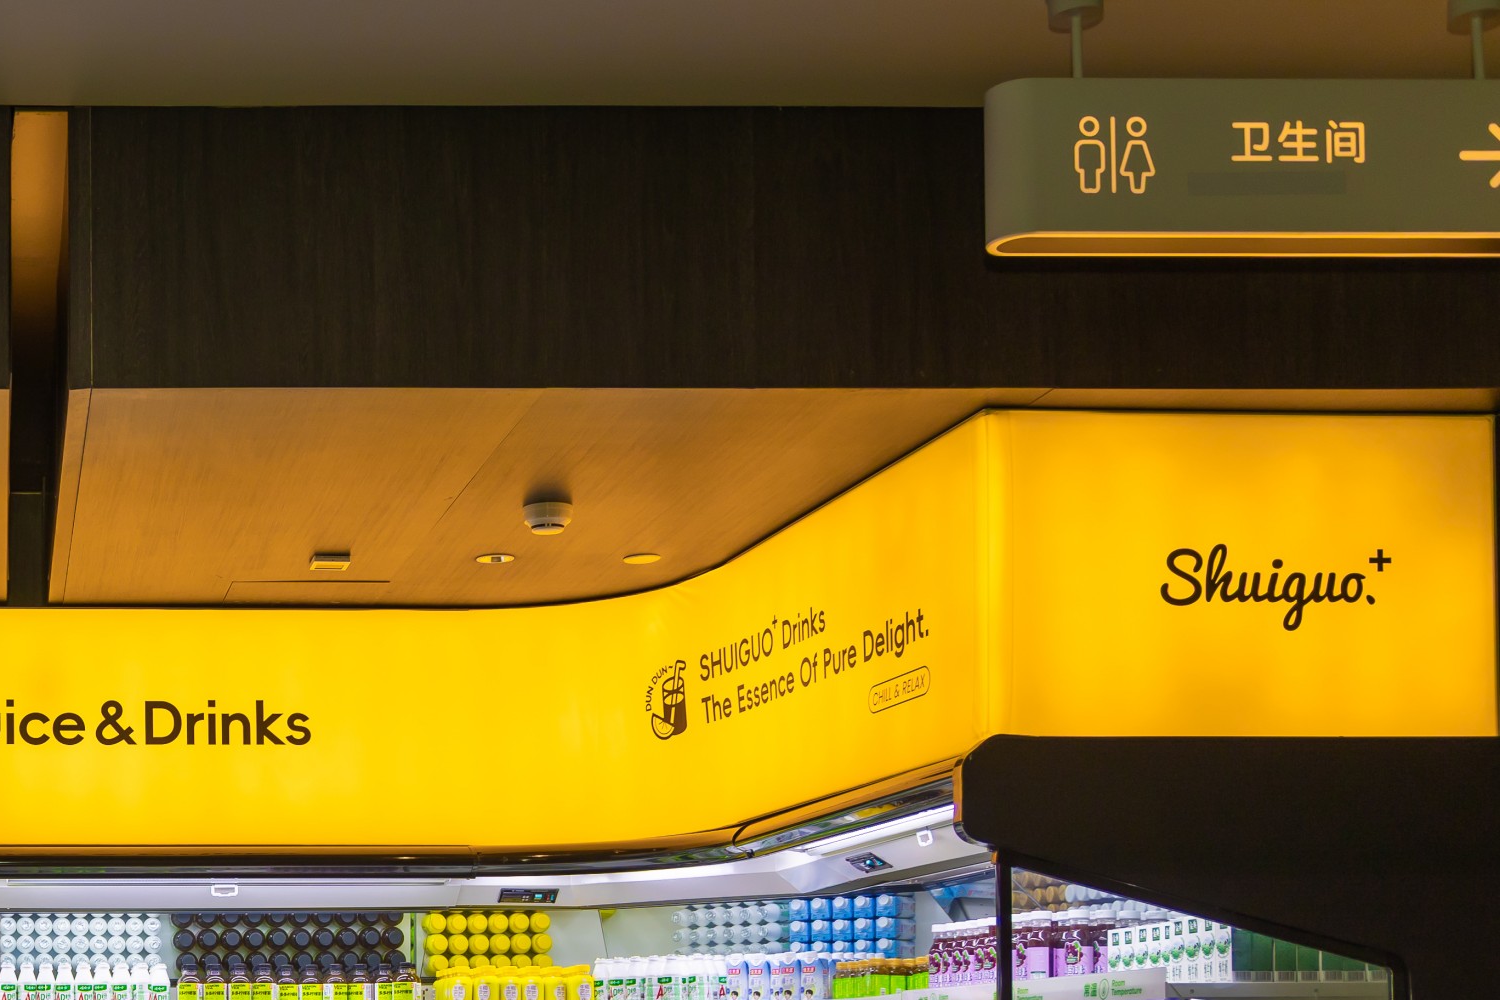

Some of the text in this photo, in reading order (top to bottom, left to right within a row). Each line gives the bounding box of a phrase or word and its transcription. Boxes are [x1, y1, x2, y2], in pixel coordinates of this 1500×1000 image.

[1231, 120, 1366, 164] 卫生间
[782, 607, 826, 650] Drinks
[701, 608, 930, 724] The Essence Of Pure Delight.
[872, 673, 926, 707] CHILL & RELAX
[95, 699, 137, 747] &
[144, 699, 312, 747] Drinks
